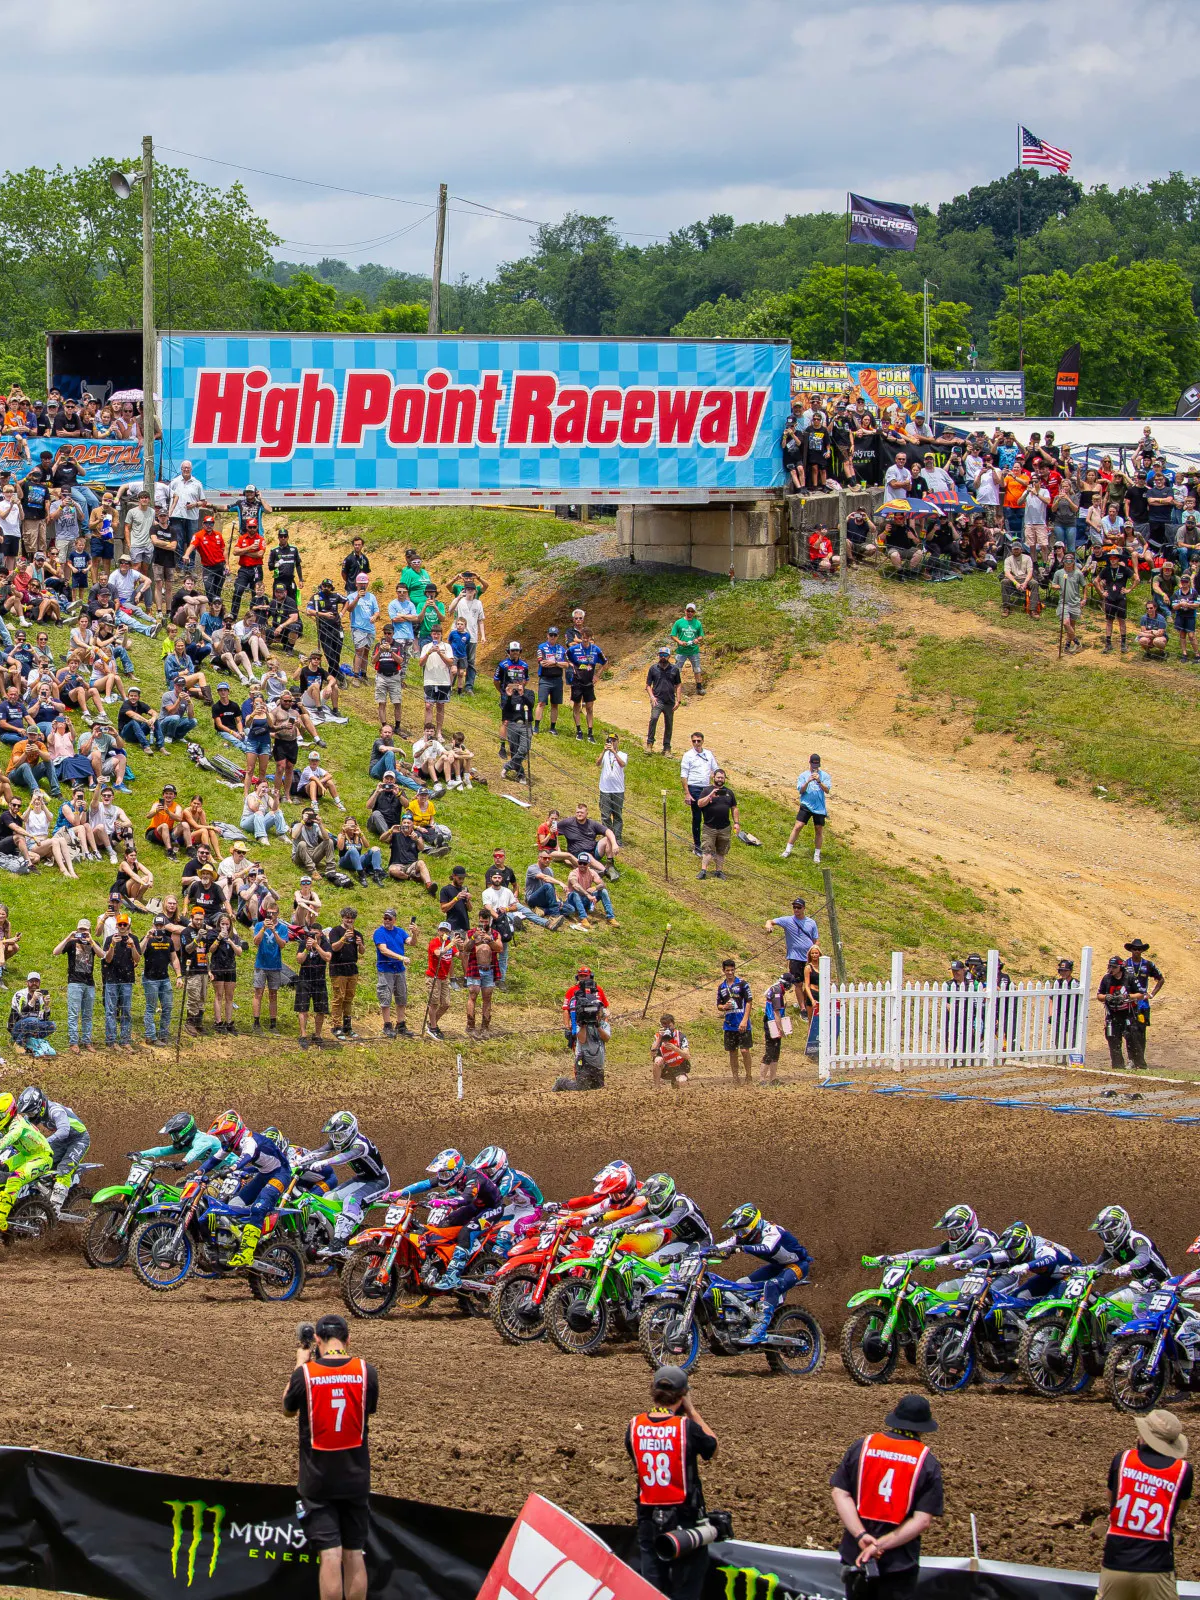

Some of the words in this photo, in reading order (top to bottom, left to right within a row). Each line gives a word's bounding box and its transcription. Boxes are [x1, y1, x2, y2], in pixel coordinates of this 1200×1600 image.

[851, 213, 918, 233] MOTOCROSS
[793, 365, 848, 379] CHICKEN
[878, 370, 910, 383] CORN
[792, 379, 850, 393] TENDERS
[878, 383, 910, 396] DOGS
[935, 384, 1022, 400] MOTOCROSS
[191, 366, 334, 462] High
[339, 366, 504, 447] Point
[506, 371, 772, 461] Raceway
[310, 1374, 363, 1385] TRANSWORLD
[332, 1388, 344, 1397] MX
[331, 1398, 346, 1432] 7
[637, 1425, 677, 1439] OCTOPI
[639, 1439, 674, 1451] MEDIA
[866, 1448, 918, 1466] ALPINESTARS
[642, 1452, 672, 1487] 38
[877, 1468, 895, 1502] 4
[1122, 1467, 1175, 1492] SWAPMOTO
[1134, 1481, 1157, 1497] LIVE
[1115, 1493, 1164, 1535] 152
[230, 1521, 307, 1549] MONS
[248, 1549, 320, 1564] ENER
